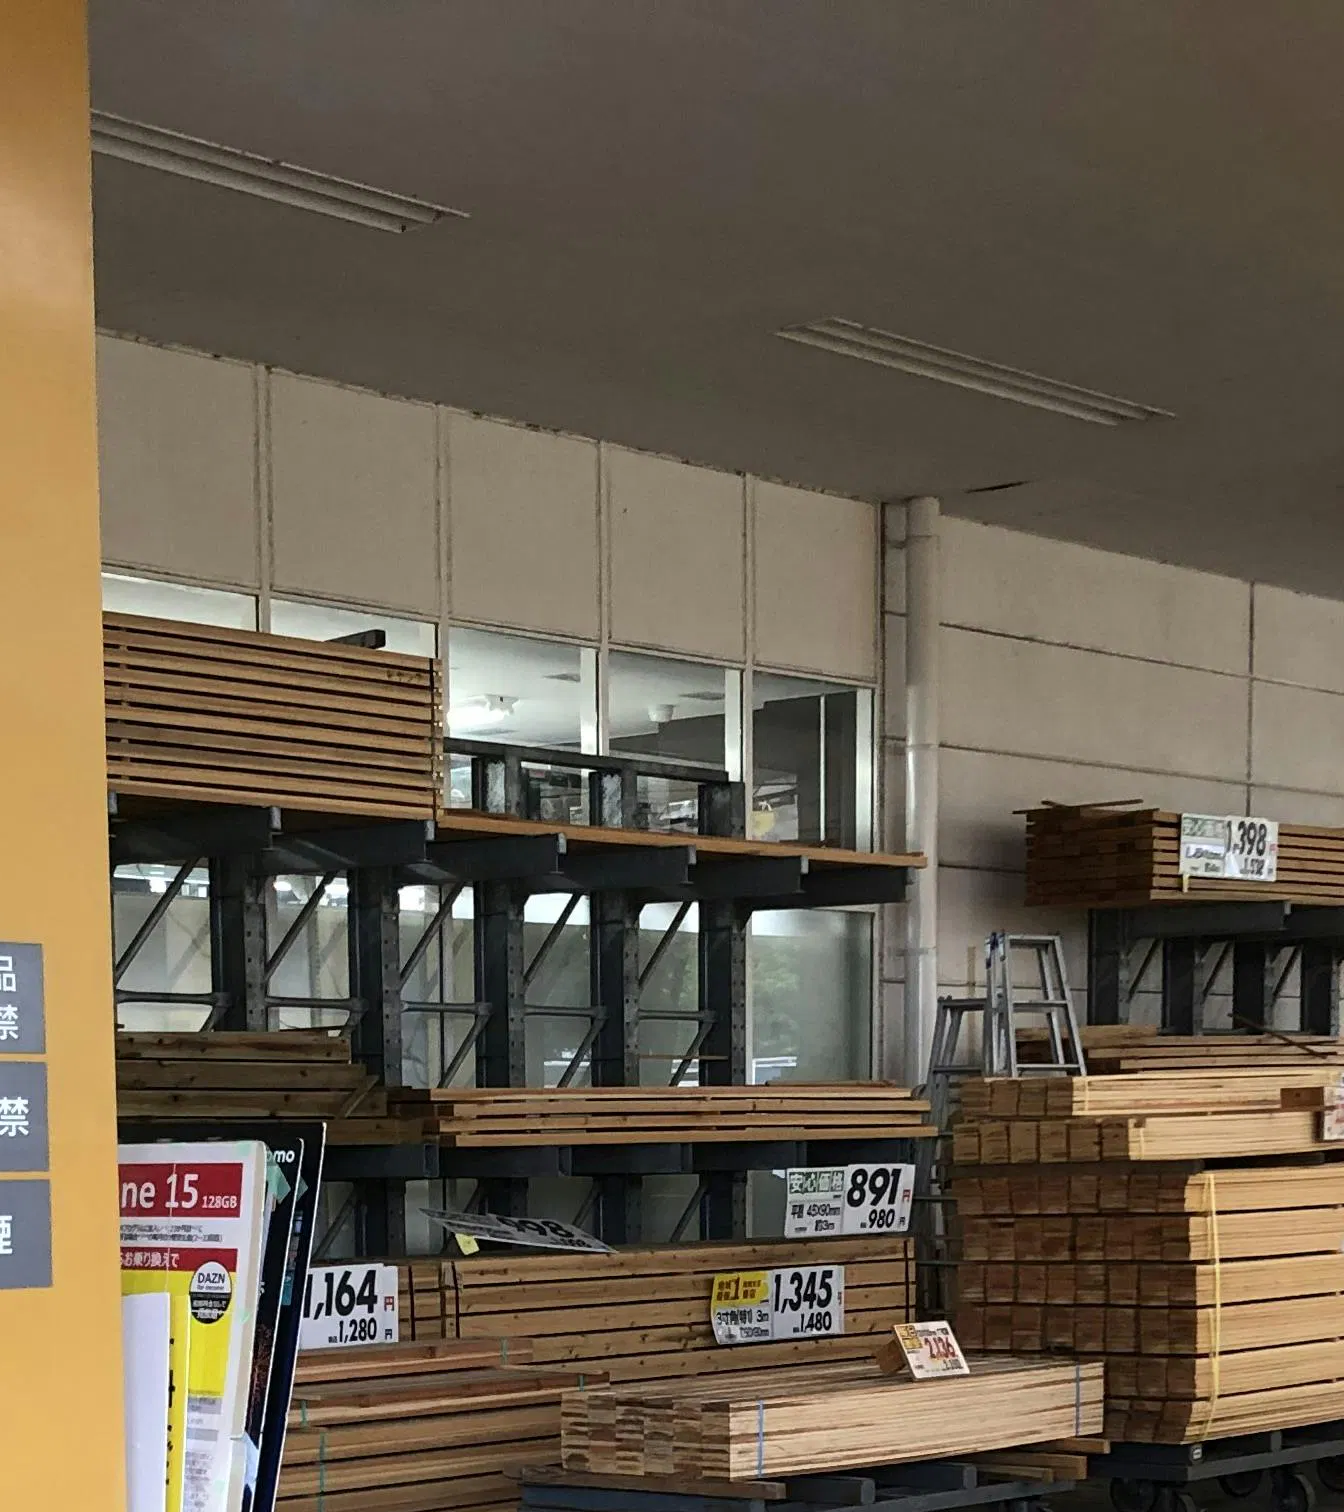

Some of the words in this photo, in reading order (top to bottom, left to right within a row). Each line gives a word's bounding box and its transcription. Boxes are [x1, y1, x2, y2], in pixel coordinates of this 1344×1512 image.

[1226, 820, 1267, 857] 1,398
[164, 1172, 199, 1209] 15
[201, 1195, 238, 1209] 128GB
[846, 1167, 902, 1208] 891
[868, 1208, 896, 1229] 980
[197, 1272, 226, 1284] DAZN
[303, 1269, 378, 1320] 1,164
[774, 1269, 834, 1314] 1,345
[339, 1317, 377, 1344] 1,280
[800, 1310, 832, 1333] 1,480
